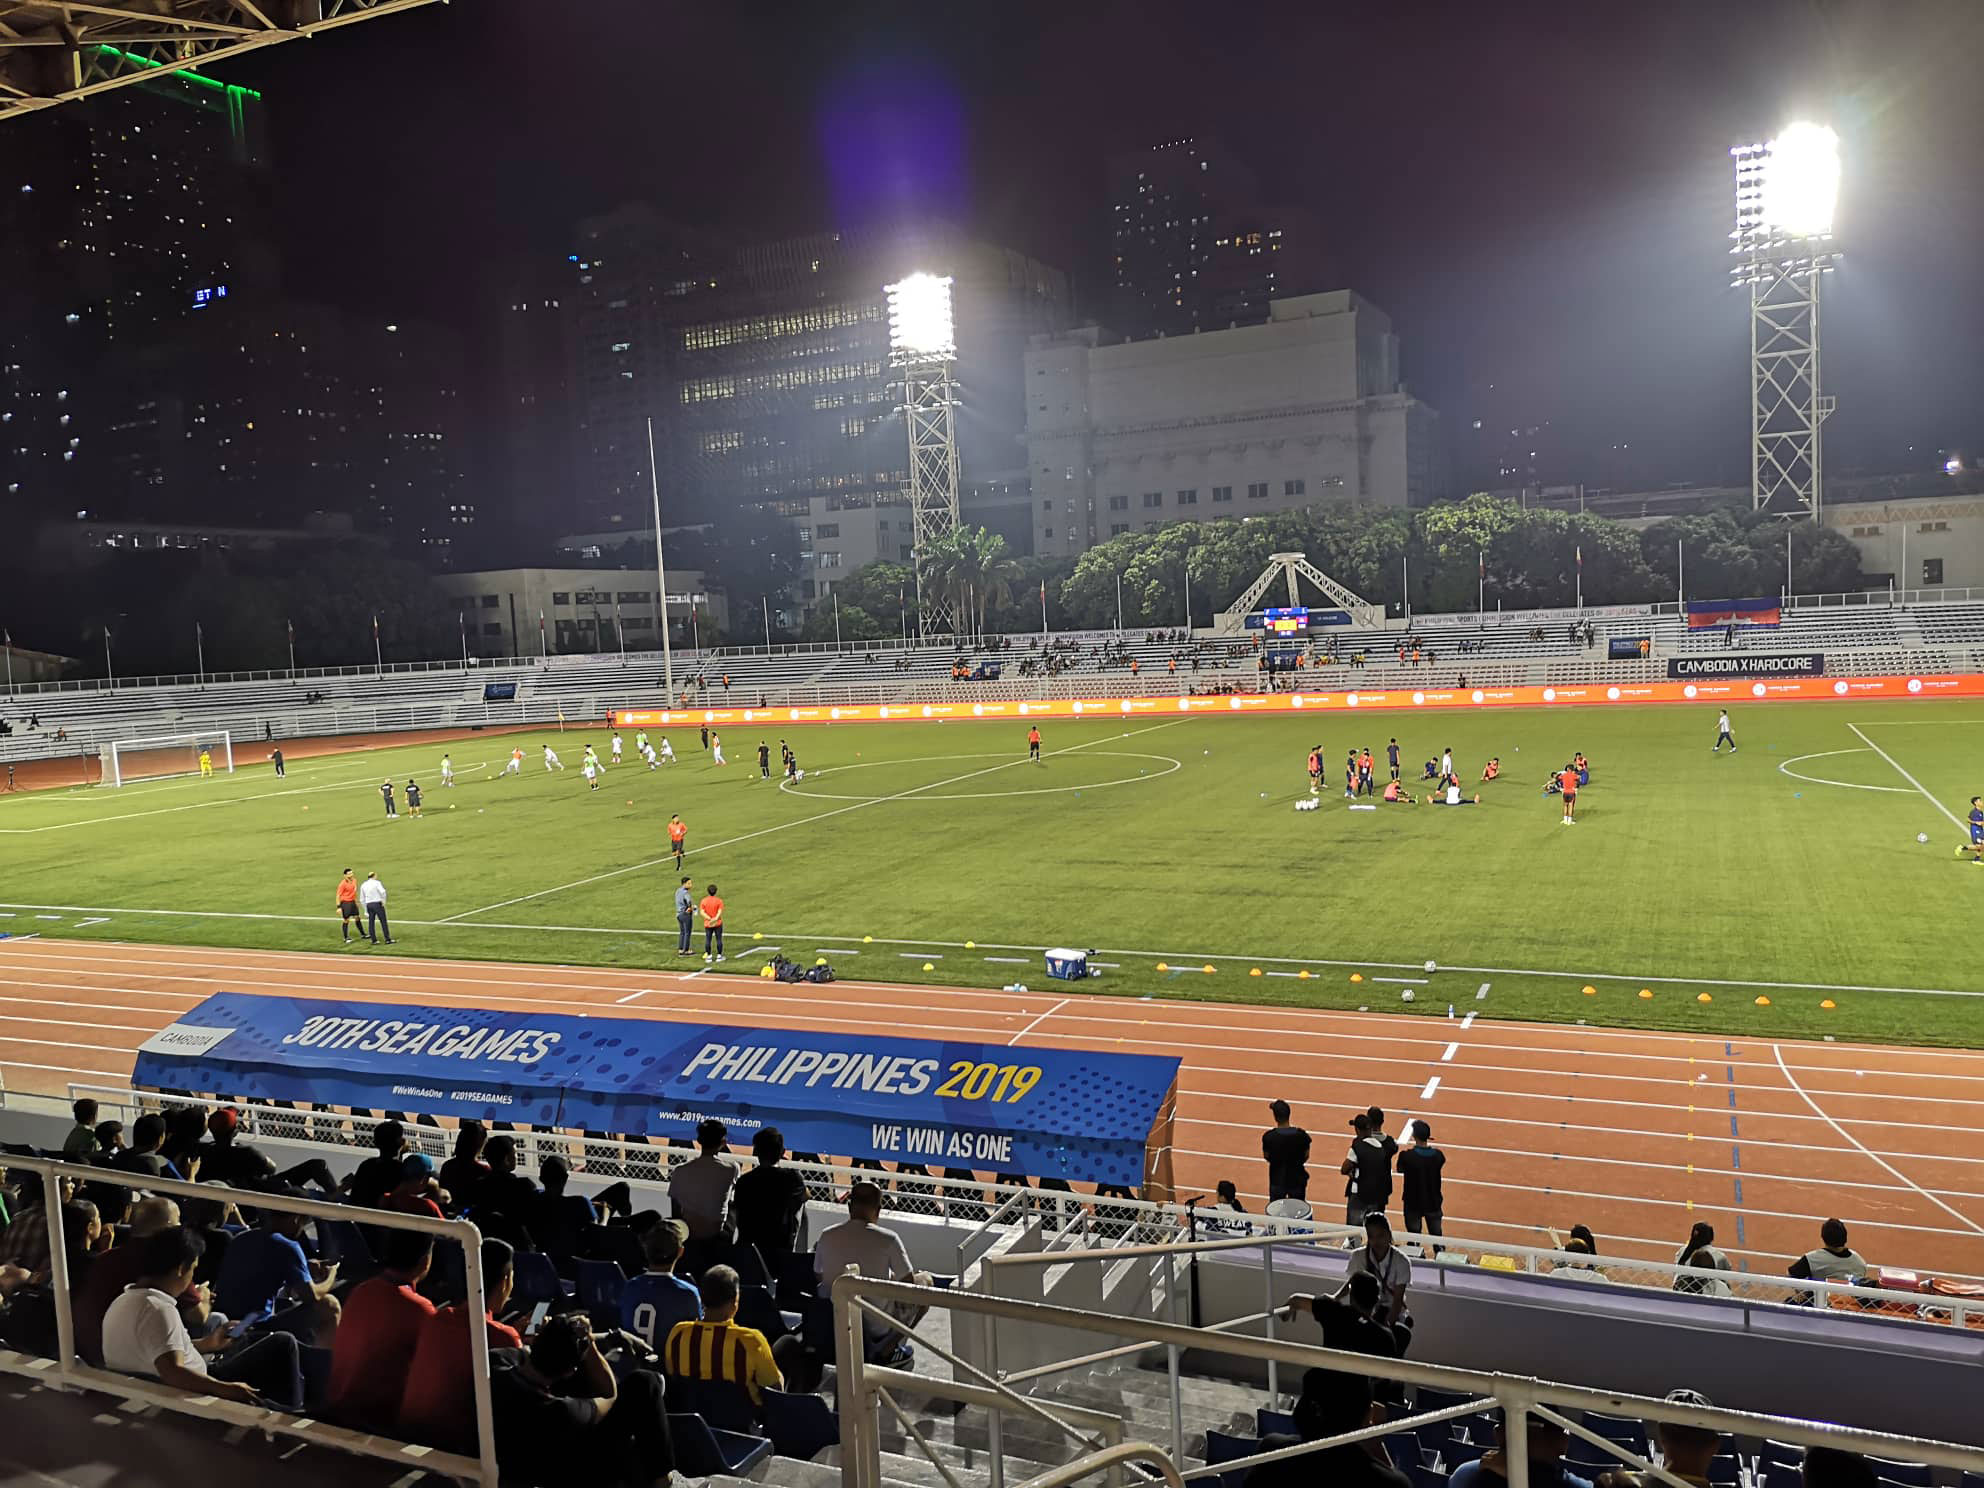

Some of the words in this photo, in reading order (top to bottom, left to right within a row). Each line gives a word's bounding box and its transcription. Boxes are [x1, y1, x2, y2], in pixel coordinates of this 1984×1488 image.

[1677, 660, 1738, 673] CAMBODIA
[1740, 659, 1748, 671] X
[1750, 657, 1812, 670] HARDCORE
[282, 1016, 374, 1049] 30TH
[359, 1020, 440, 1055] SEA
[427, 1025, 561, 1064] GAMES
[681, 1043, 940, 1096] PHILIPPINES
[934, 1060, 1043, 1103] 2019
[392, 1085, 444, 1099] #WeWinAsOne
[450, 1091, 513, 1105] #2019SEAGAMES
[872, 1124, 900, 1151] WE
[906, 1127, 945, 1155] WIN
[946, 1134, 974, 1159] AS
[975, 1136, 1013, 1162] ONE
[633, 1303, 656, 1345] 9
